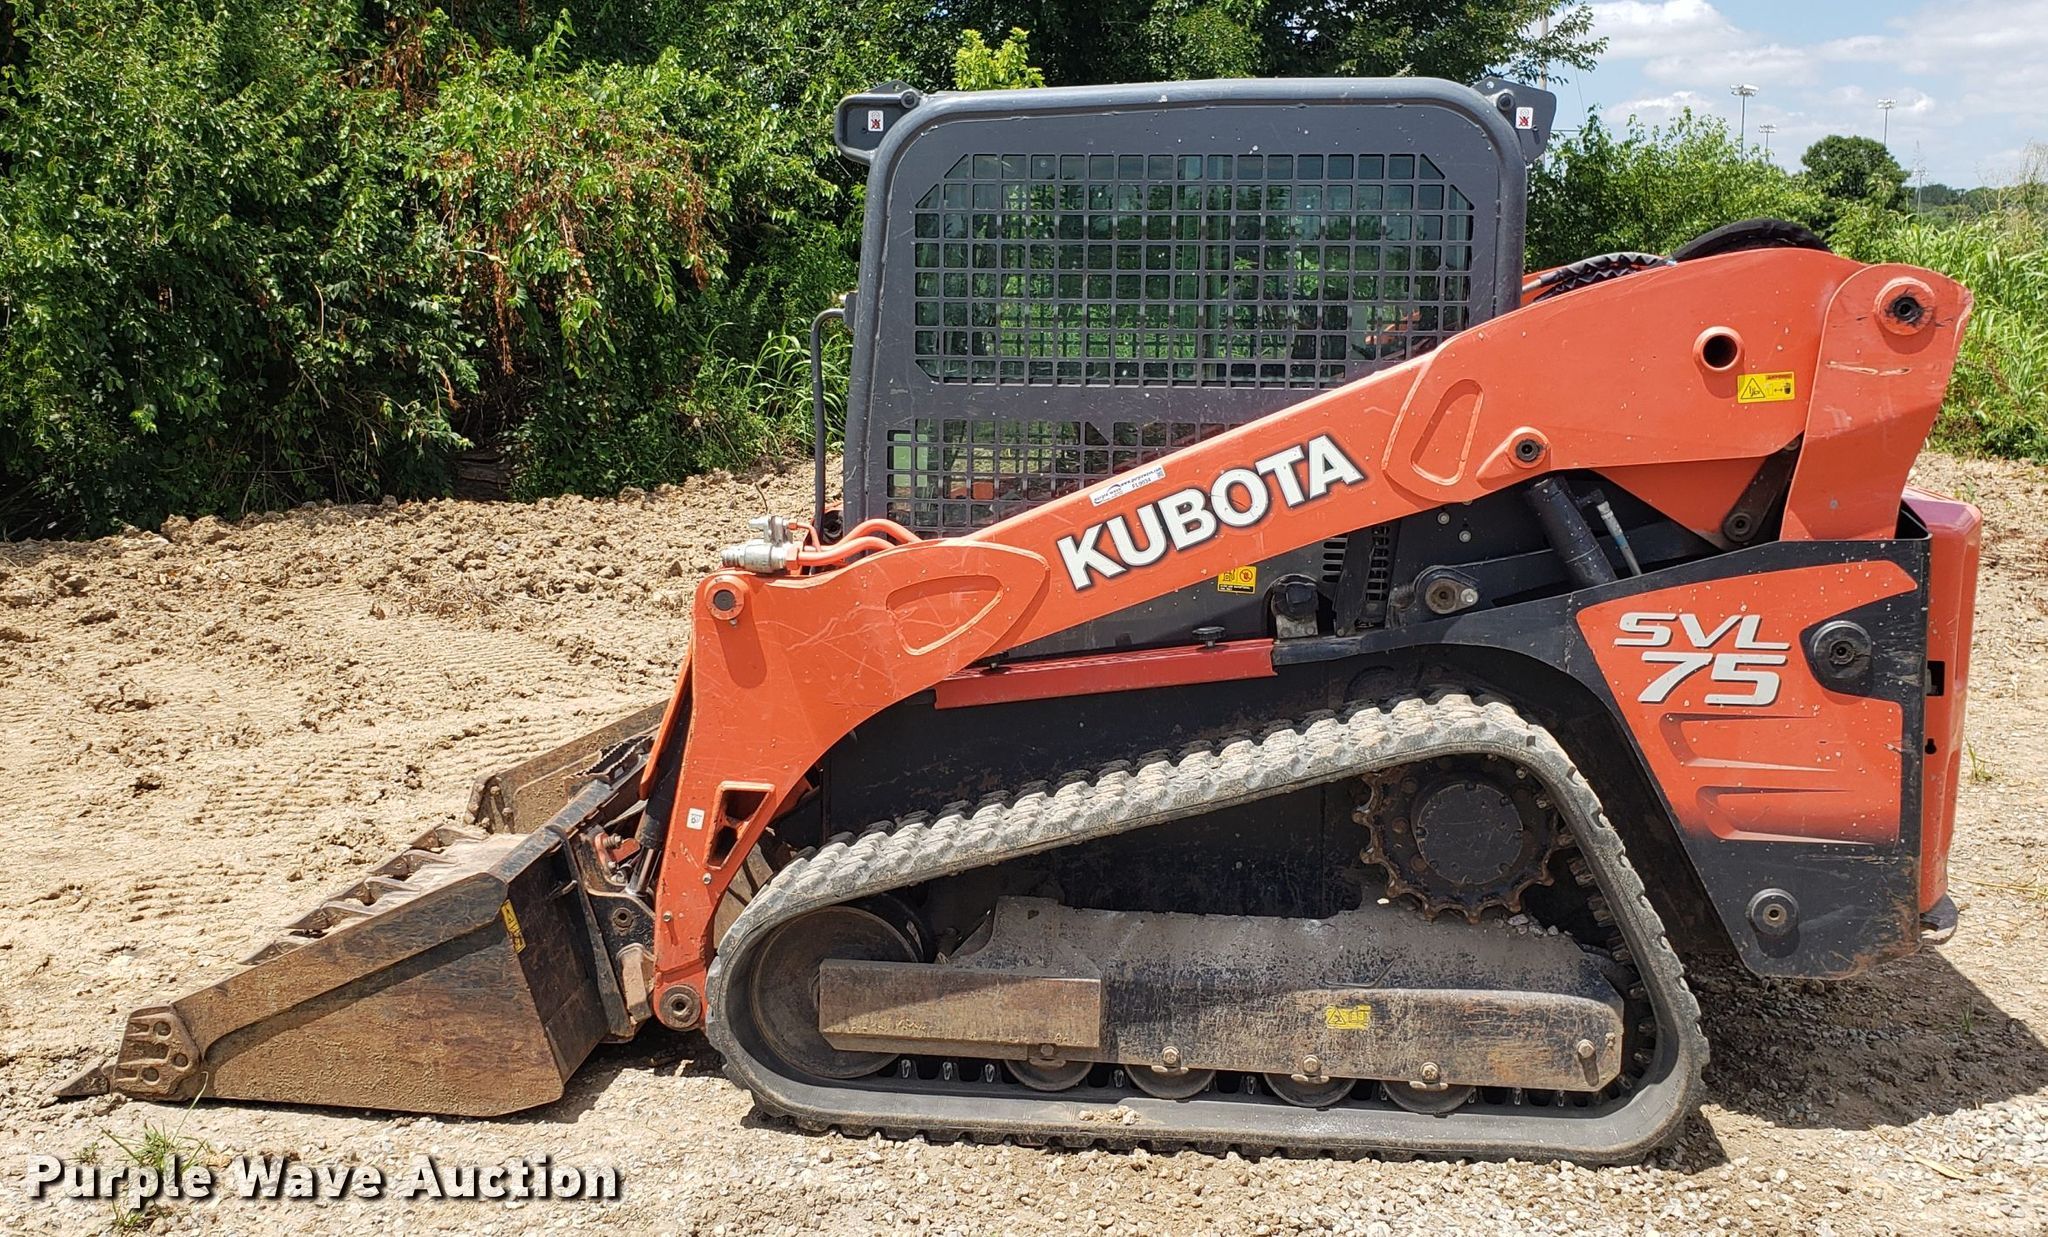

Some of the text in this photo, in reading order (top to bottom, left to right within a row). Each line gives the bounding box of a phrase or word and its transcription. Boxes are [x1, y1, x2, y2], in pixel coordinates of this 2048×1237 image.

[1057, 434, 1365, 591] KUBOTA
[1614, 612, 1791, 650] SVL
[1637, 651, 1787, 706] 75
